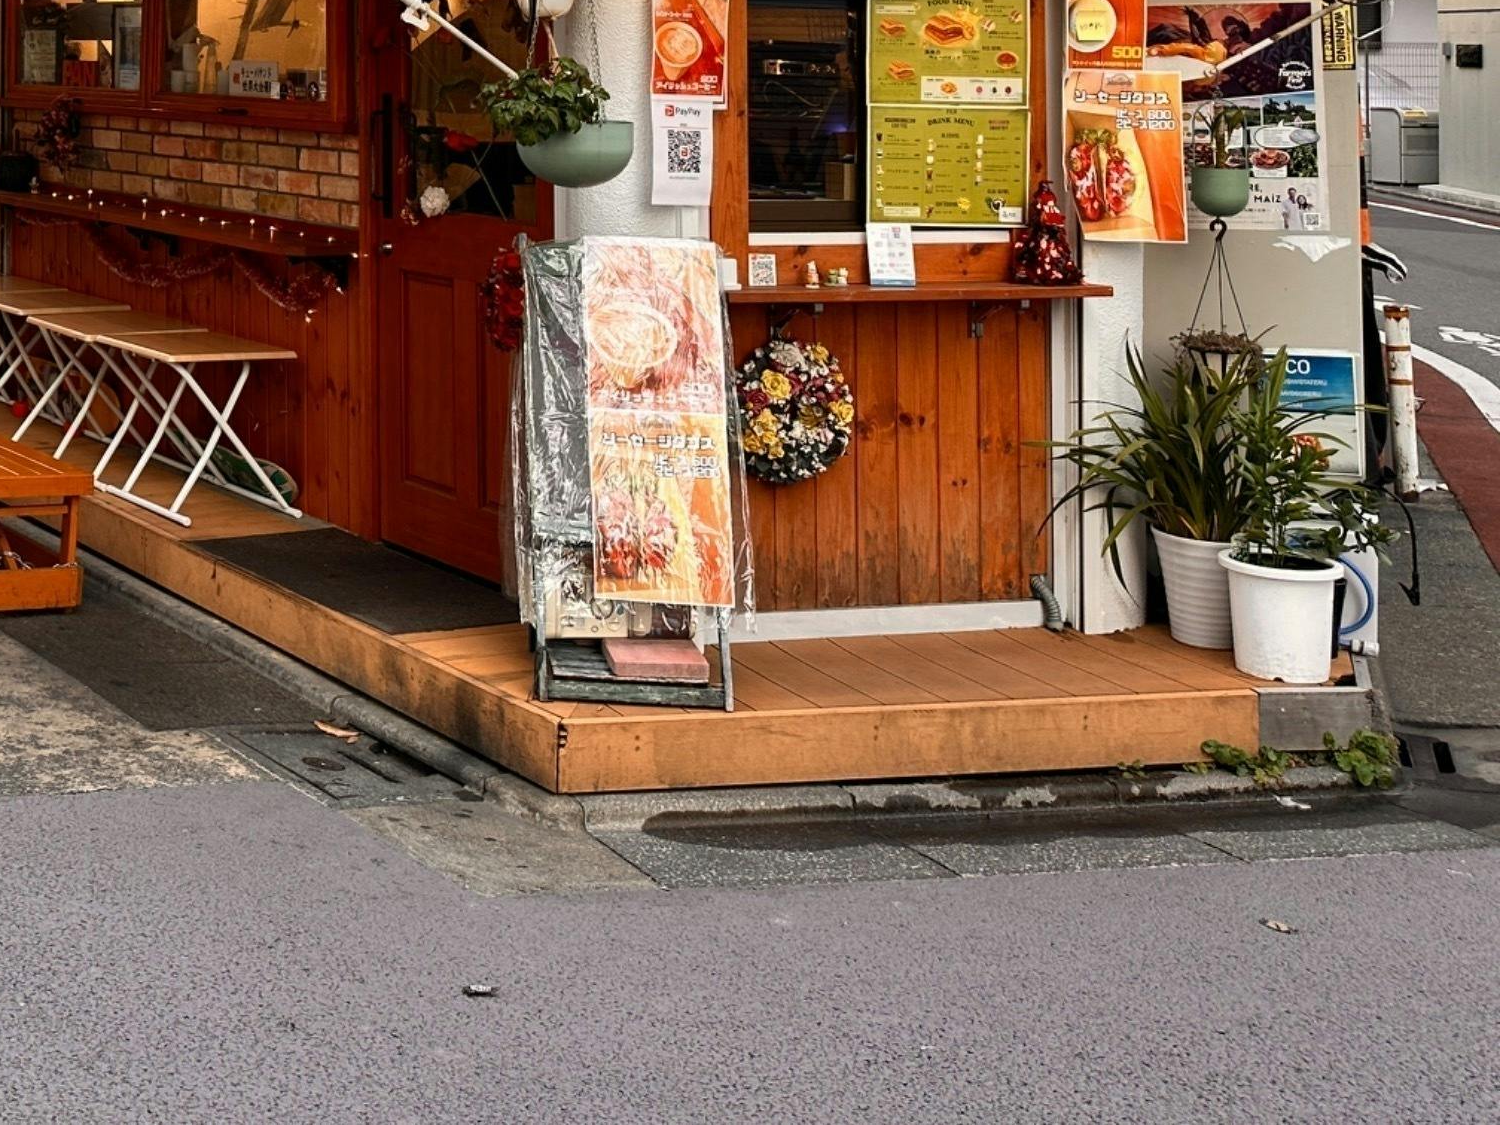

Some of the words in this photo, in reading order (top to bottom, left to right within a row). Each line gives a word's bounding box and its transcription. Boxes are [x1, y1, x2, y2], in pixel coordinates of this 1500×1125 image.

[1334, 11, 1347, 63] WARNING
[1112, 45, 1142, 58] 500
[1075, 90, 1171, 104] ソーセージタコス
[675, 106, 701, 117] PayPay
[927, 117, 951, 126] DRINK
[953, 117, 976, 127] MENU
